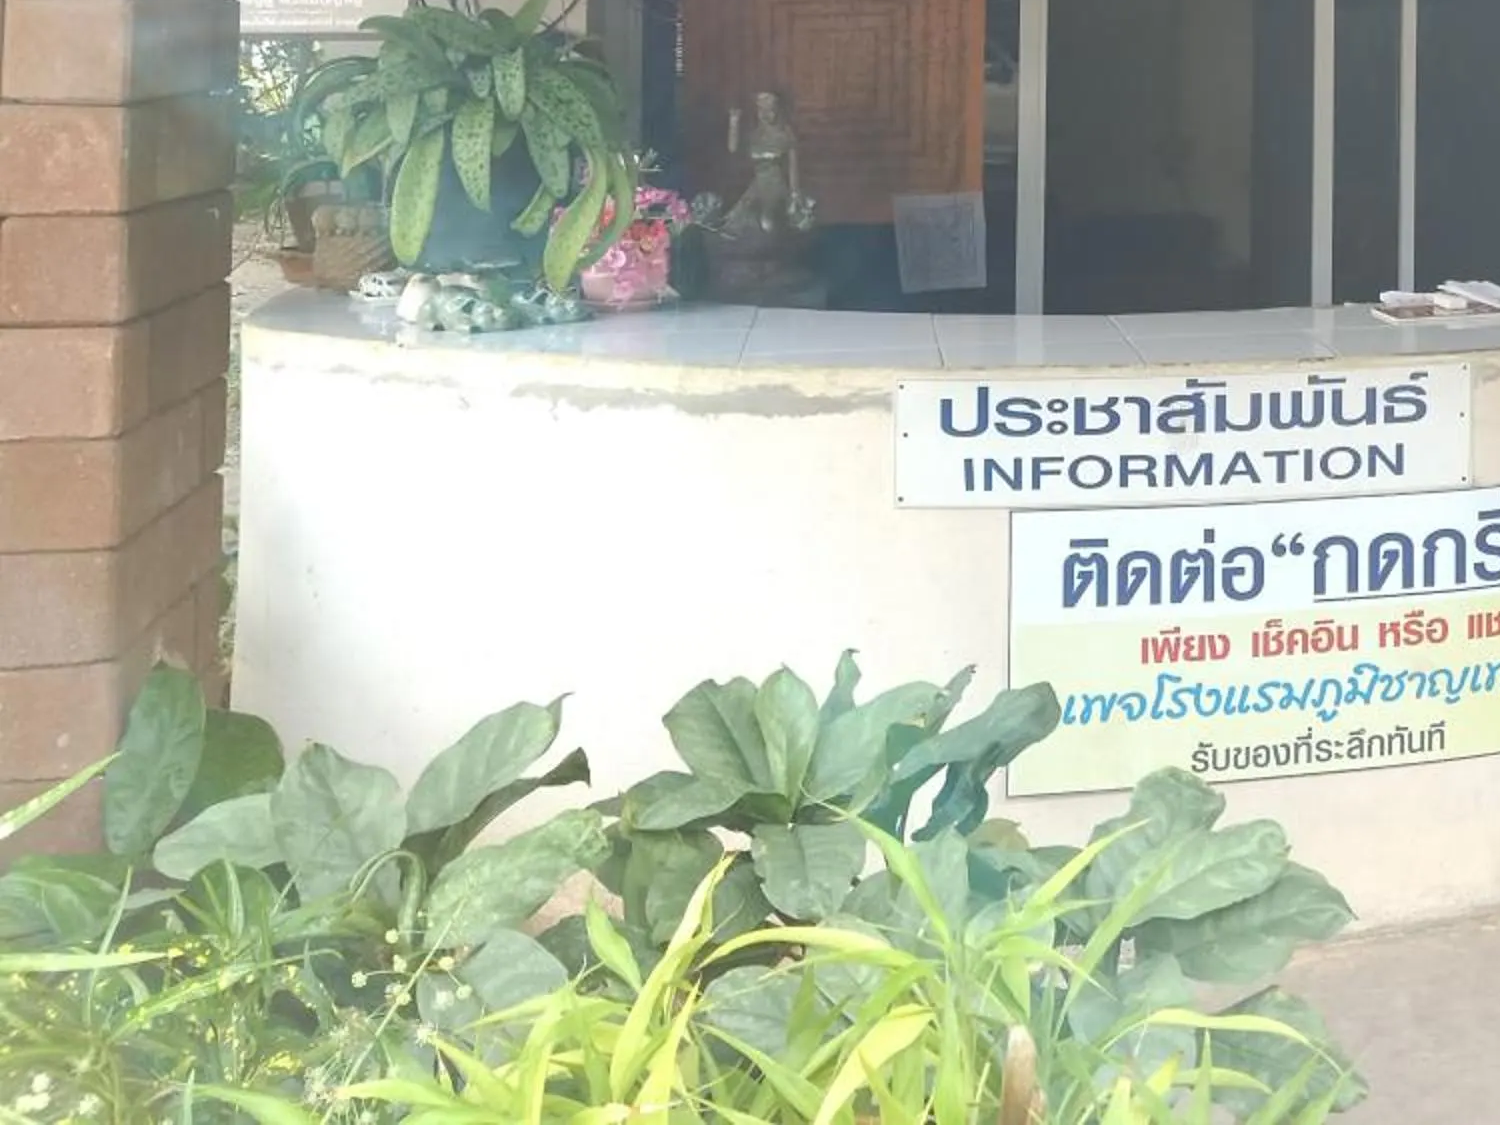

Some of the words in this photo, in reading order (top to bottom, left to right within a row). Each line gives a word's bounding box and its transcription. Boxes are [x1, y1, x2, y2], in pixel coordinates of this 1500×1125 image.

[939, 371, 1429, 439] ประชาสัมพันธ์
[962, 442, 1406, 491] INFORMATION
[1140, 626, 1231, 664] เพียง
[1251, 618, 1359, 658] เช็คอิน
[1379, 609, 1449, 649] หรือ
[1191, 721, 1446, 773] รับของที่ระลึกทันที
